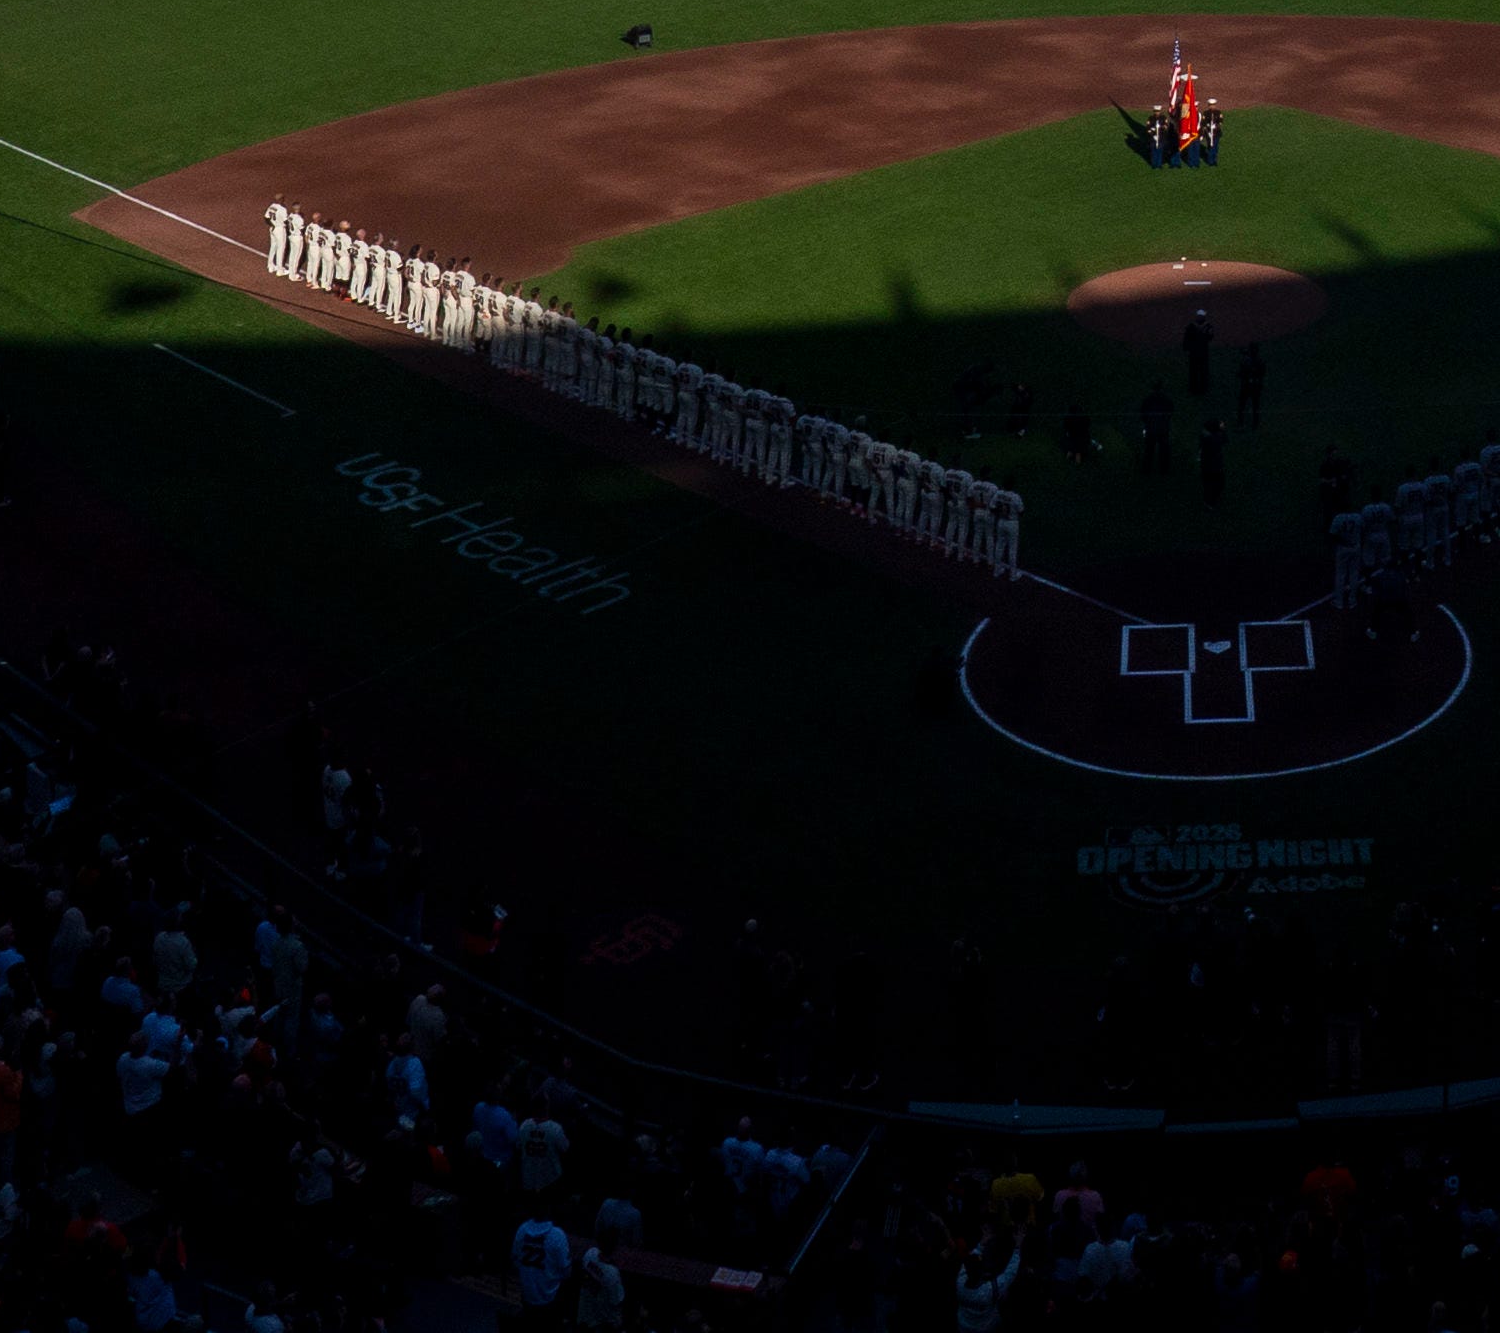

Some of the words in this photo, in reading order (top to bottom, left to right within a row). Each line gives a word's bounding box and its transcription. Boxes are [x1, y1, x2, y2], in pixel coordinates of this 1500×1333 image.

[334, 452, 444, 513] UCSF
[411, 501, 632, 615] Health
[1076, 842, 1251, 876] OPENING
[1254, 836, 1376, 869] NIGHT
